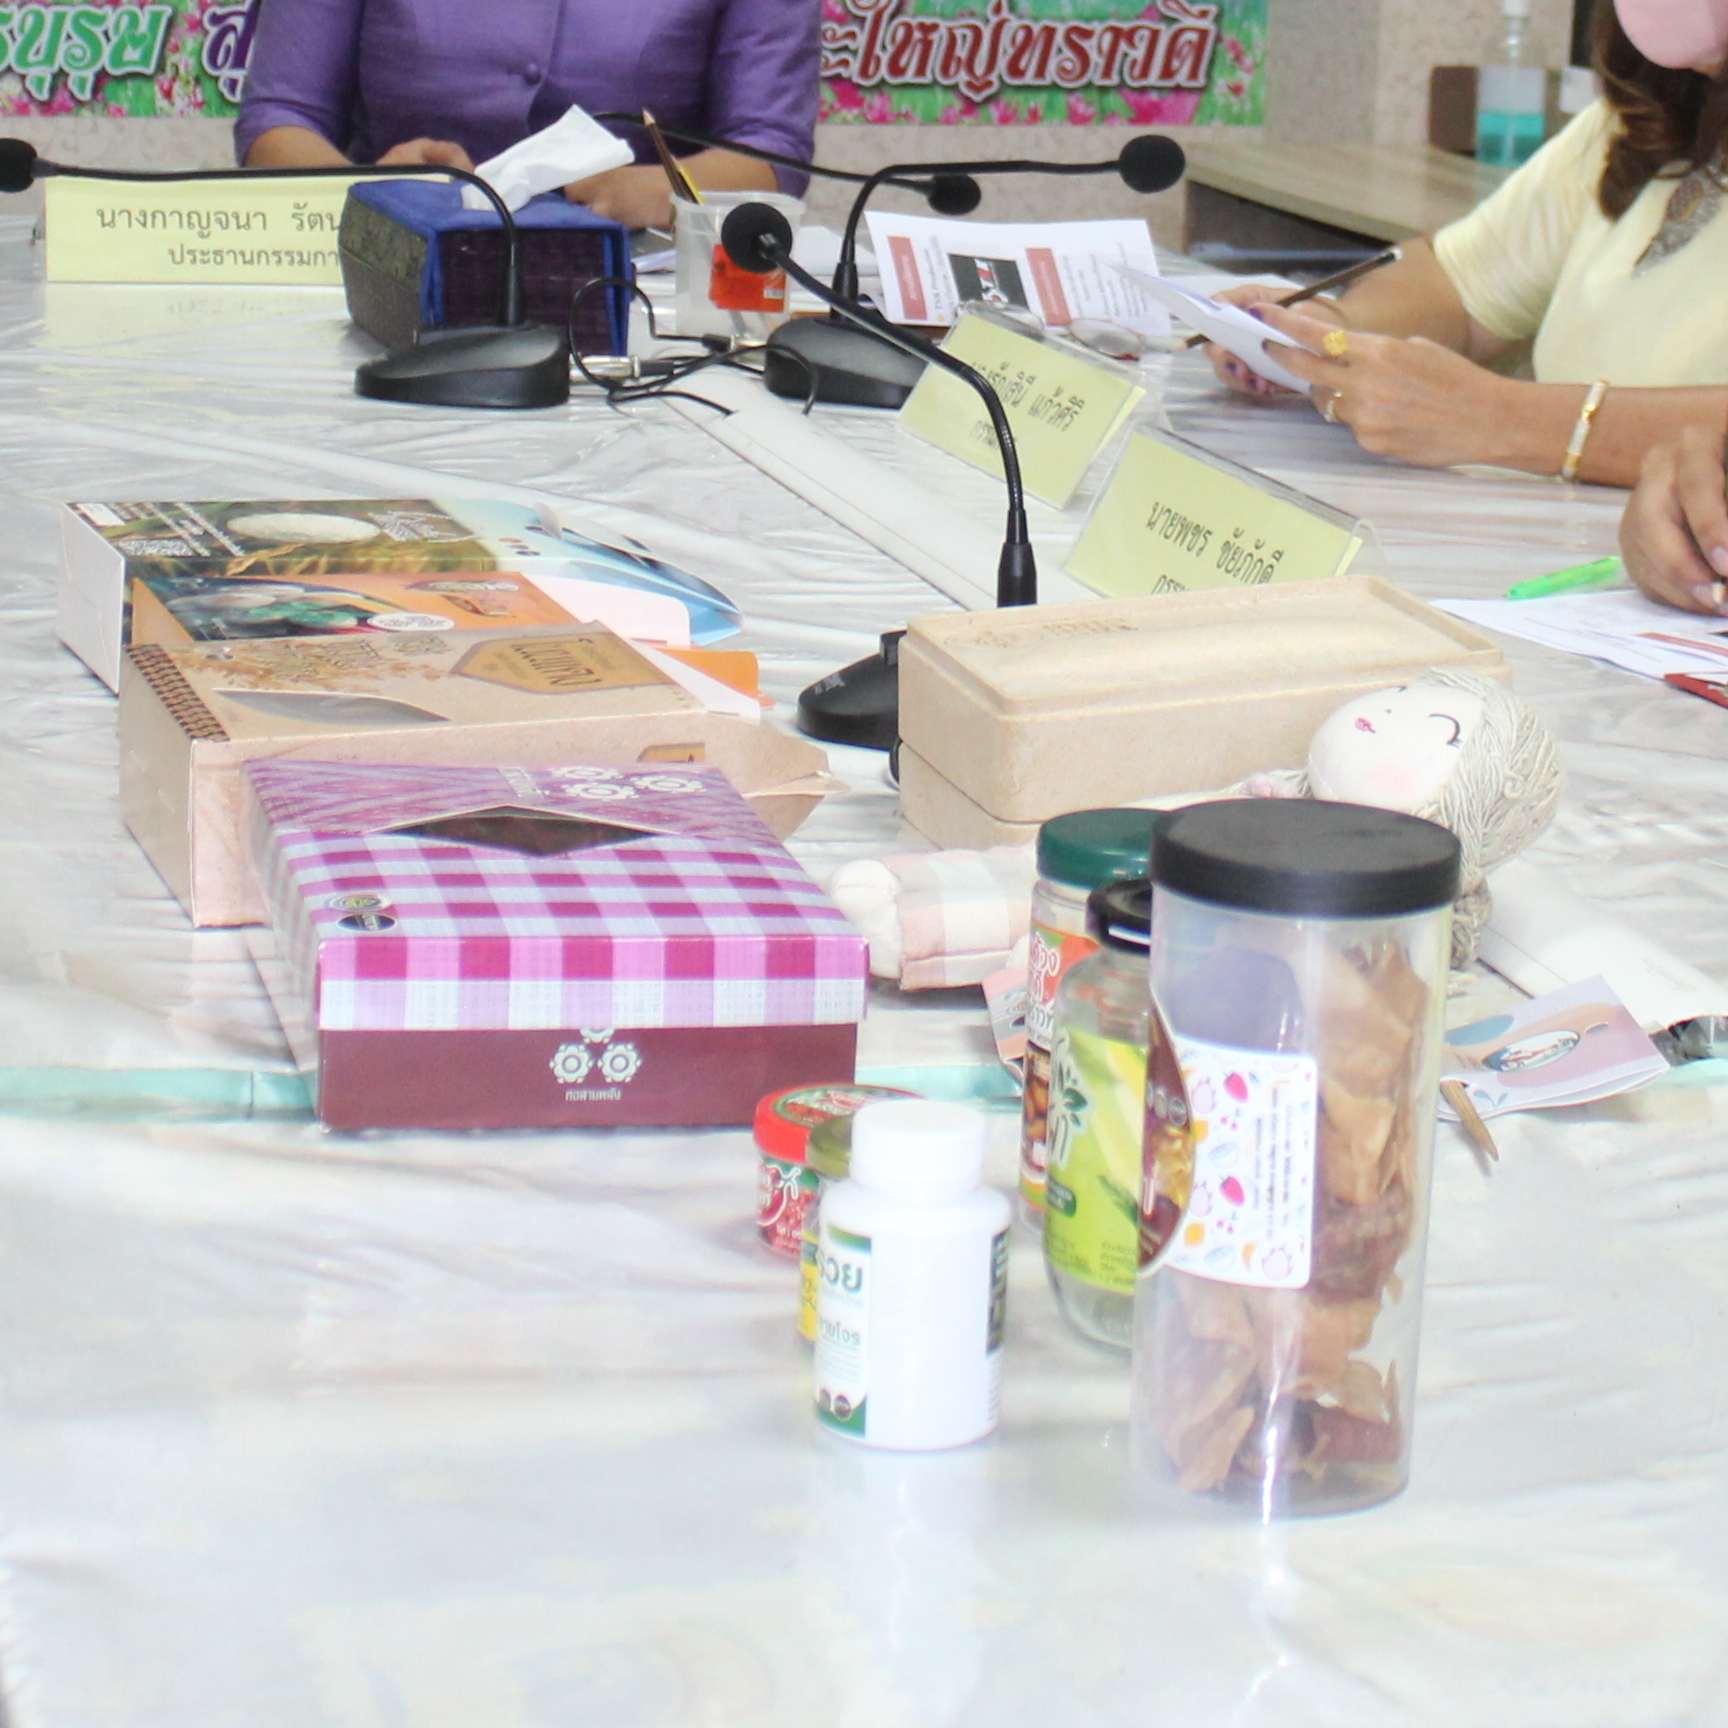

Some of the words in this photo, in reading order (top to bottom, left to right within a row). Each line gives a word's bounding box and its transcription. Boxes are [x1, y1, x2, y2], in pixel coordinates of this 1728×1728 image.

[96, 208, 267, 238] นางกาญจนา
[291, 202, 341, 232] รัตน
[168, 244, 340, 267] ประธานกรรมกา
[1146, 502, 1214, 557] นายพชร
[1216, 527, 1285, 584] ชัยภักดี
